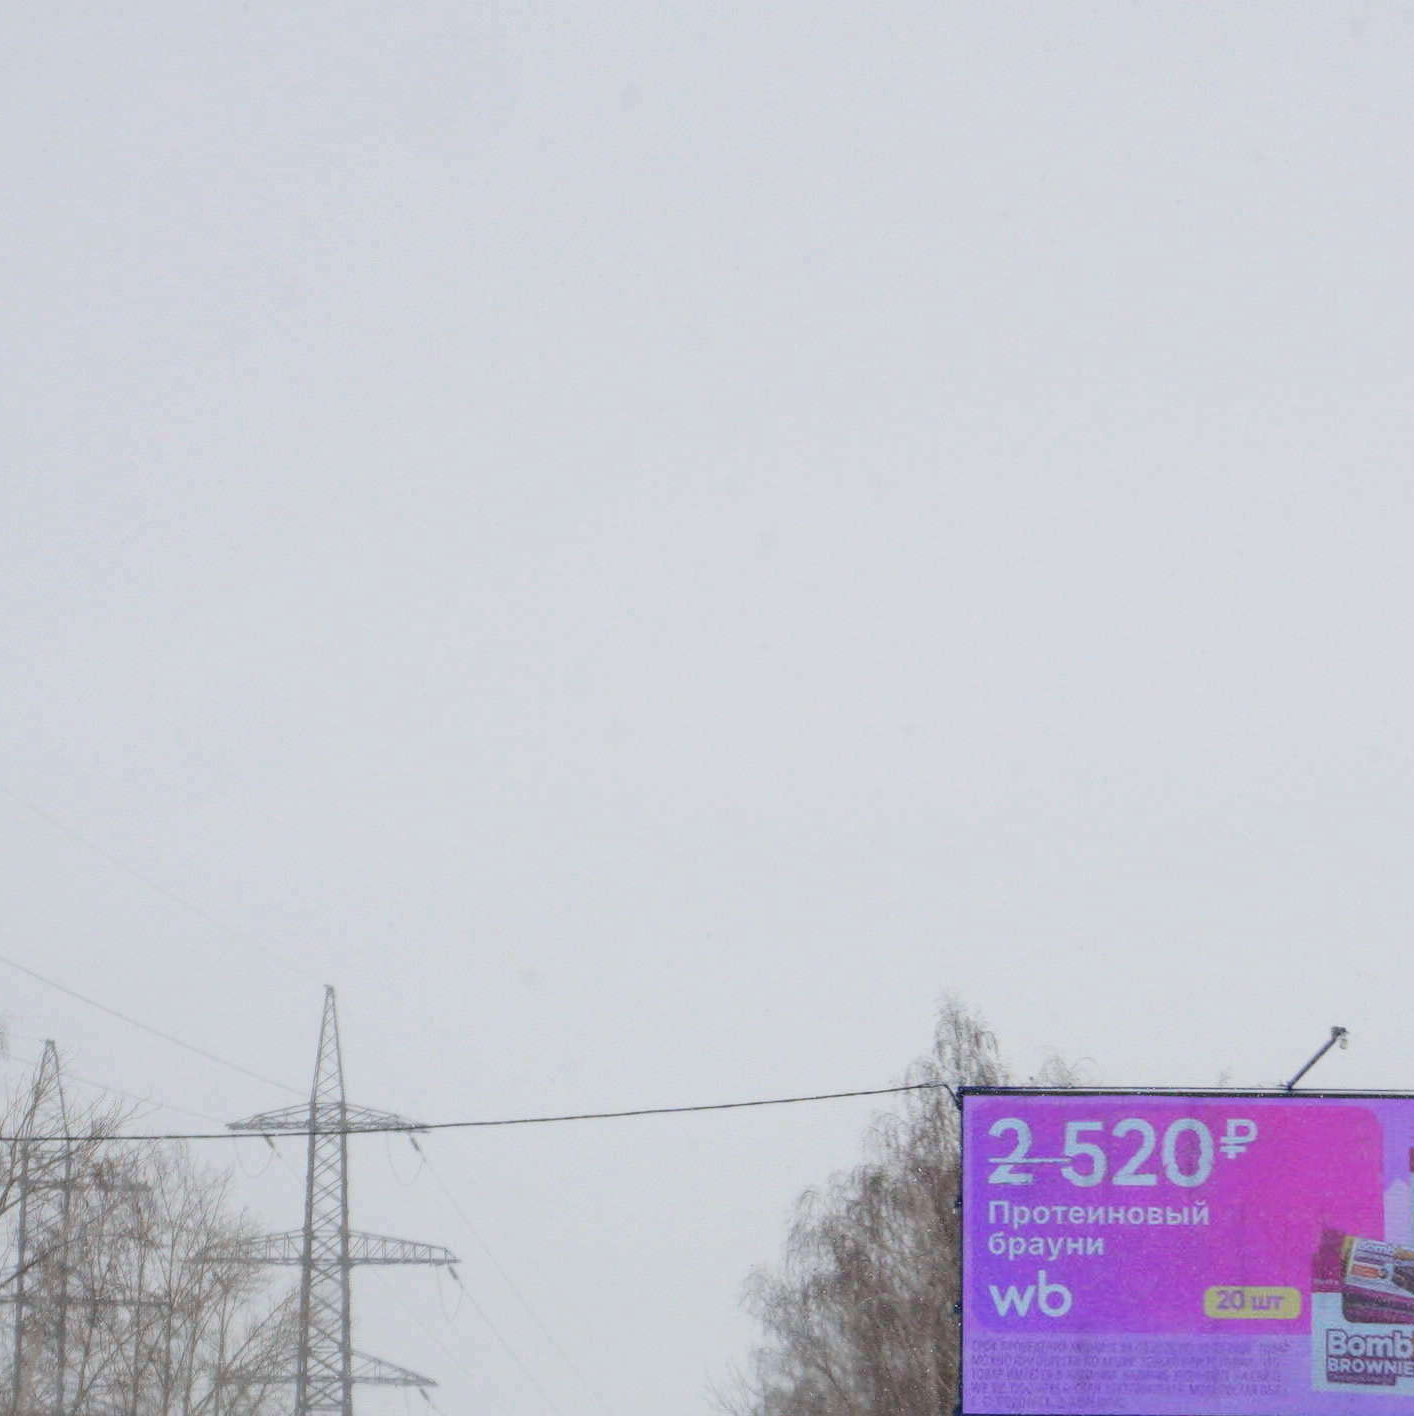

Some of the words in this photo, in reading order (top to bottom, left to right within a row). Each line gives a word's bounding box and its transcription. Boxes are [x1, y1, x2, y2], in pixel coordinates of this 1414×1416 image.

[988, 1117, 1033, 1184] 2
[988, 1200, 1209, 1229] Протеиновый
[988, 1232, 1105, 1261] брауни
[988, 1269, 1074, 1317] wb
[1216, 1289, 1245, 1311] 20
[1250, 1292, 1285, 1310] шт
[1327, 1357, 1414, 1376] BROWNIE
